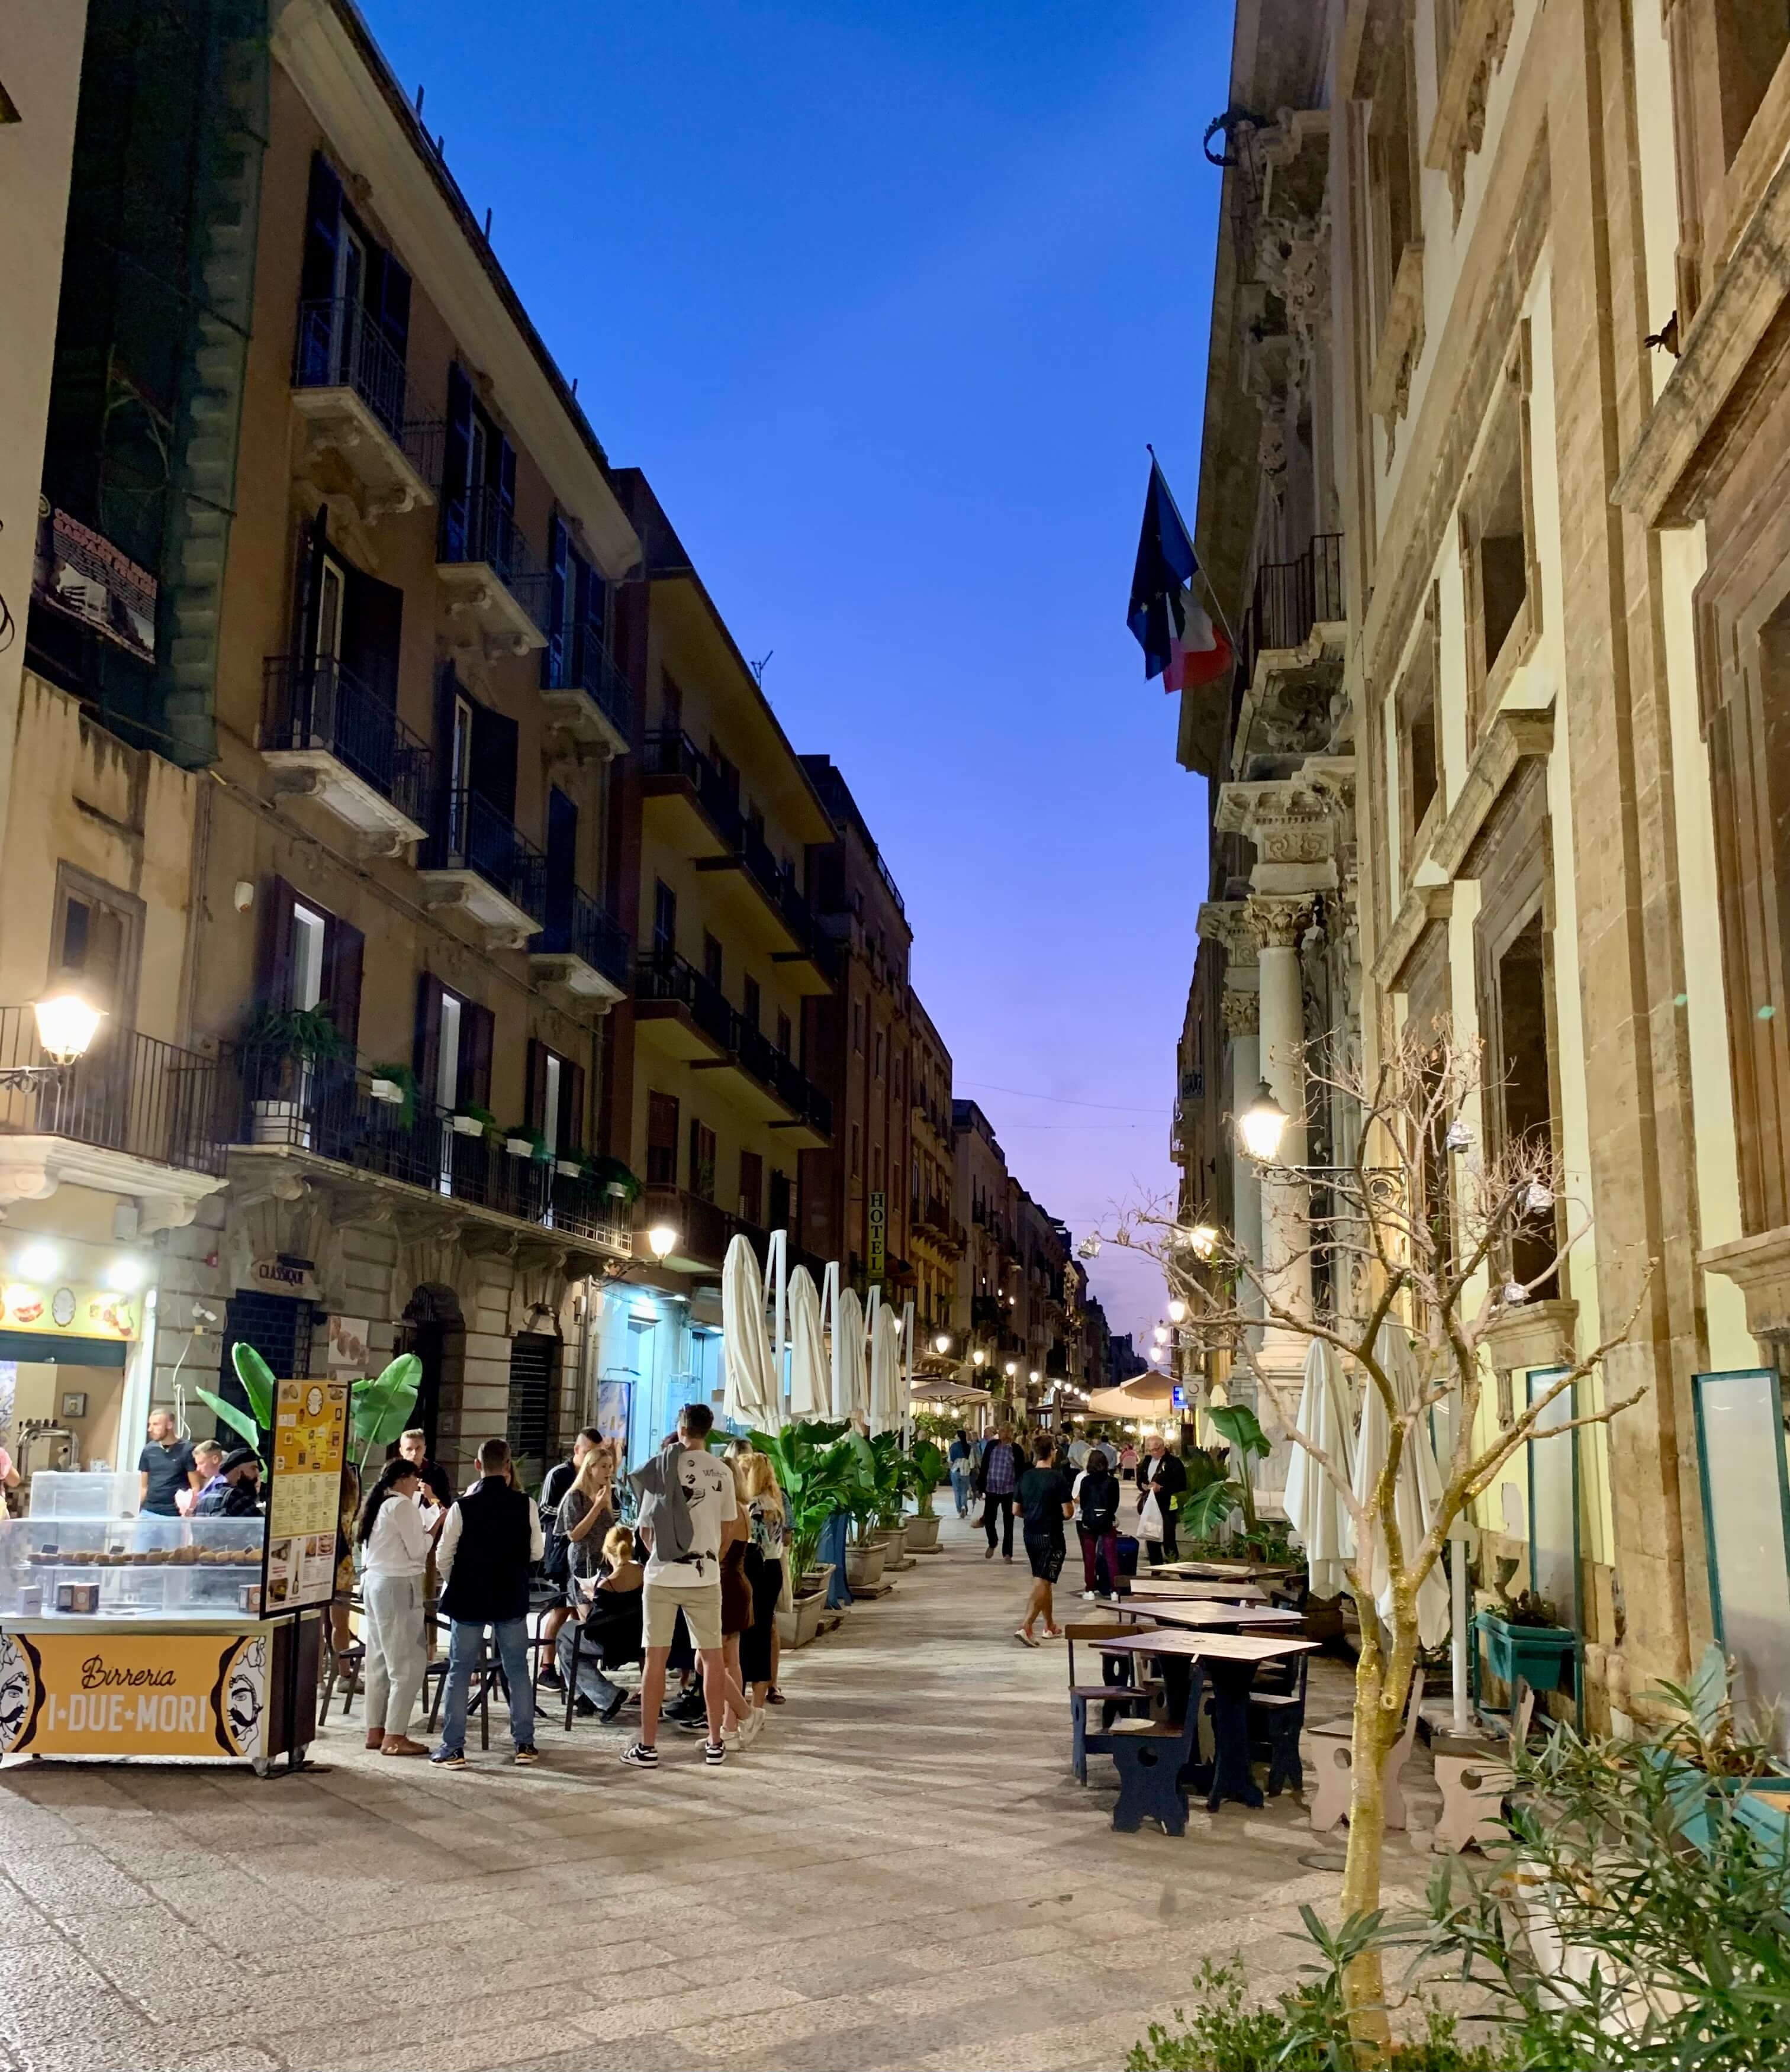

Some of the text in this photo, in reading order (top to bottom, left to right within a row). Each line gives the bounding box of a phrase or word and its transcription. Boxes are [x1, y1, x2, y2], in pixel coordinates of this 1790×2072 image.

[871, 1194, 883, 1270] HOTEL
[259, 1264, 303, 1287] CLASSIQUE
[81, 1654, 176, 1689] Birreria
[47, 1693, 207, 1732] I DUE MORI
